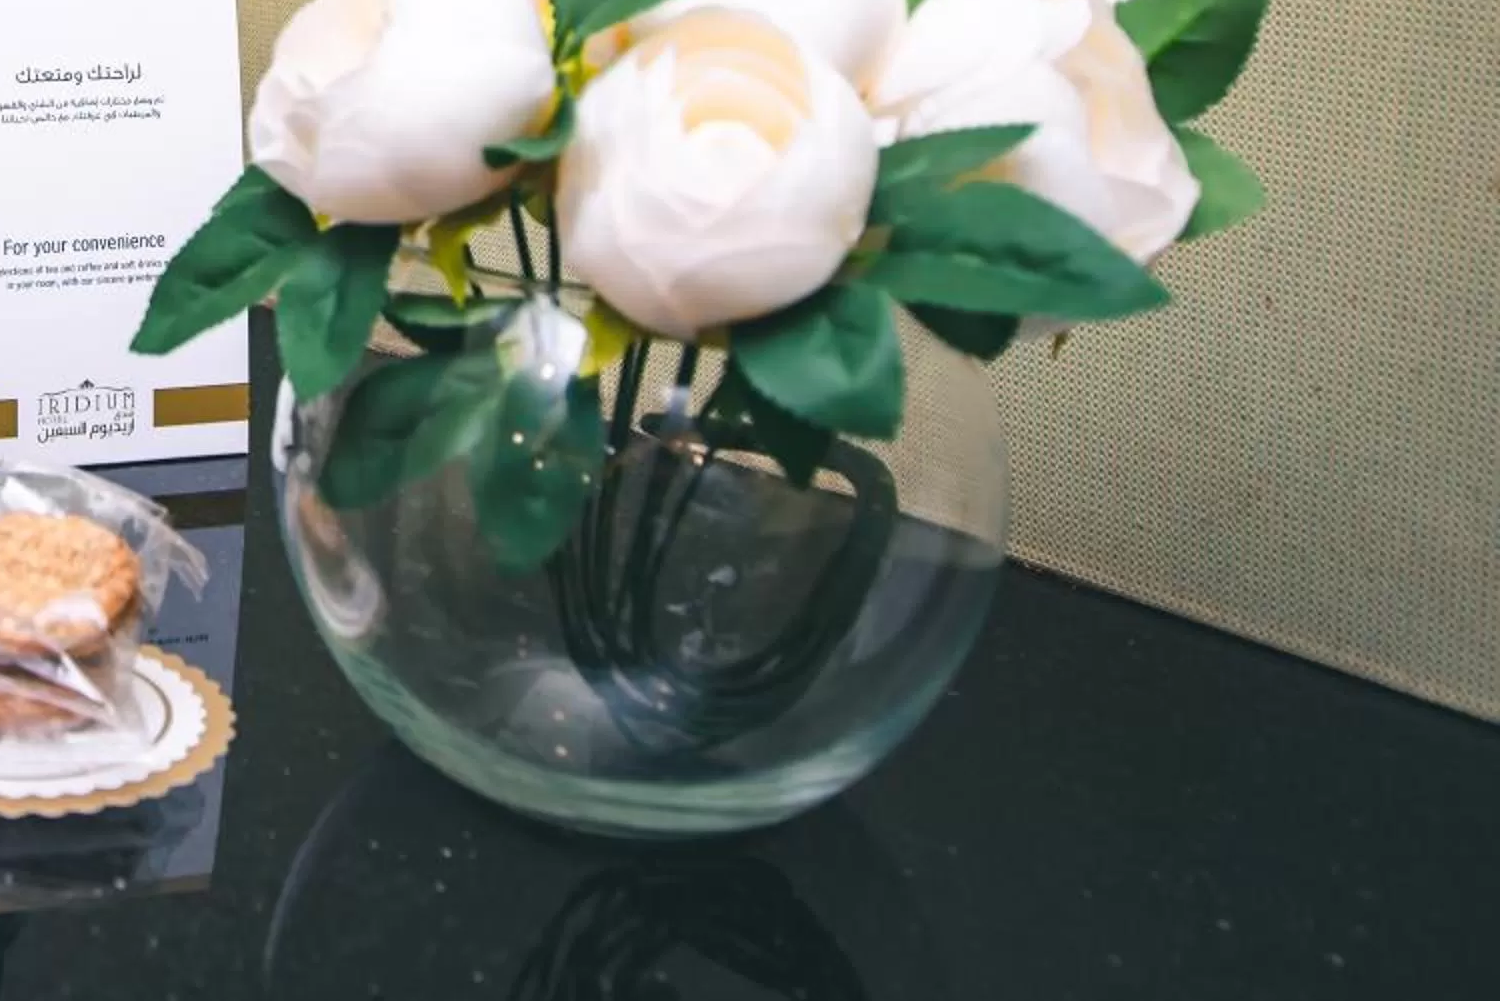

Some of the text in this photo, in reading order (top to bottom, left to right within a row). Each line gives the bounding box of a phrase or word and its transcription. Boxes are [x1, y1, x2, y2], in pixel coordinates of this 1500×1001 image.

[15, 63, 142, 86] لراحتك ومتعتك
[3, 232, 165, 258] For your convenience
[46, 265, 58, 273] tea
[77, 261, 102, 272] coffee
[104, 260, 118, 270] and
[120, 259, 136, 270] soft
[138, 257, 162, 268] drinks
[15, 281, 32, 292] your
[61, 277, 79, 286] with
[37, 391, 135, 416] IRIDIUM
